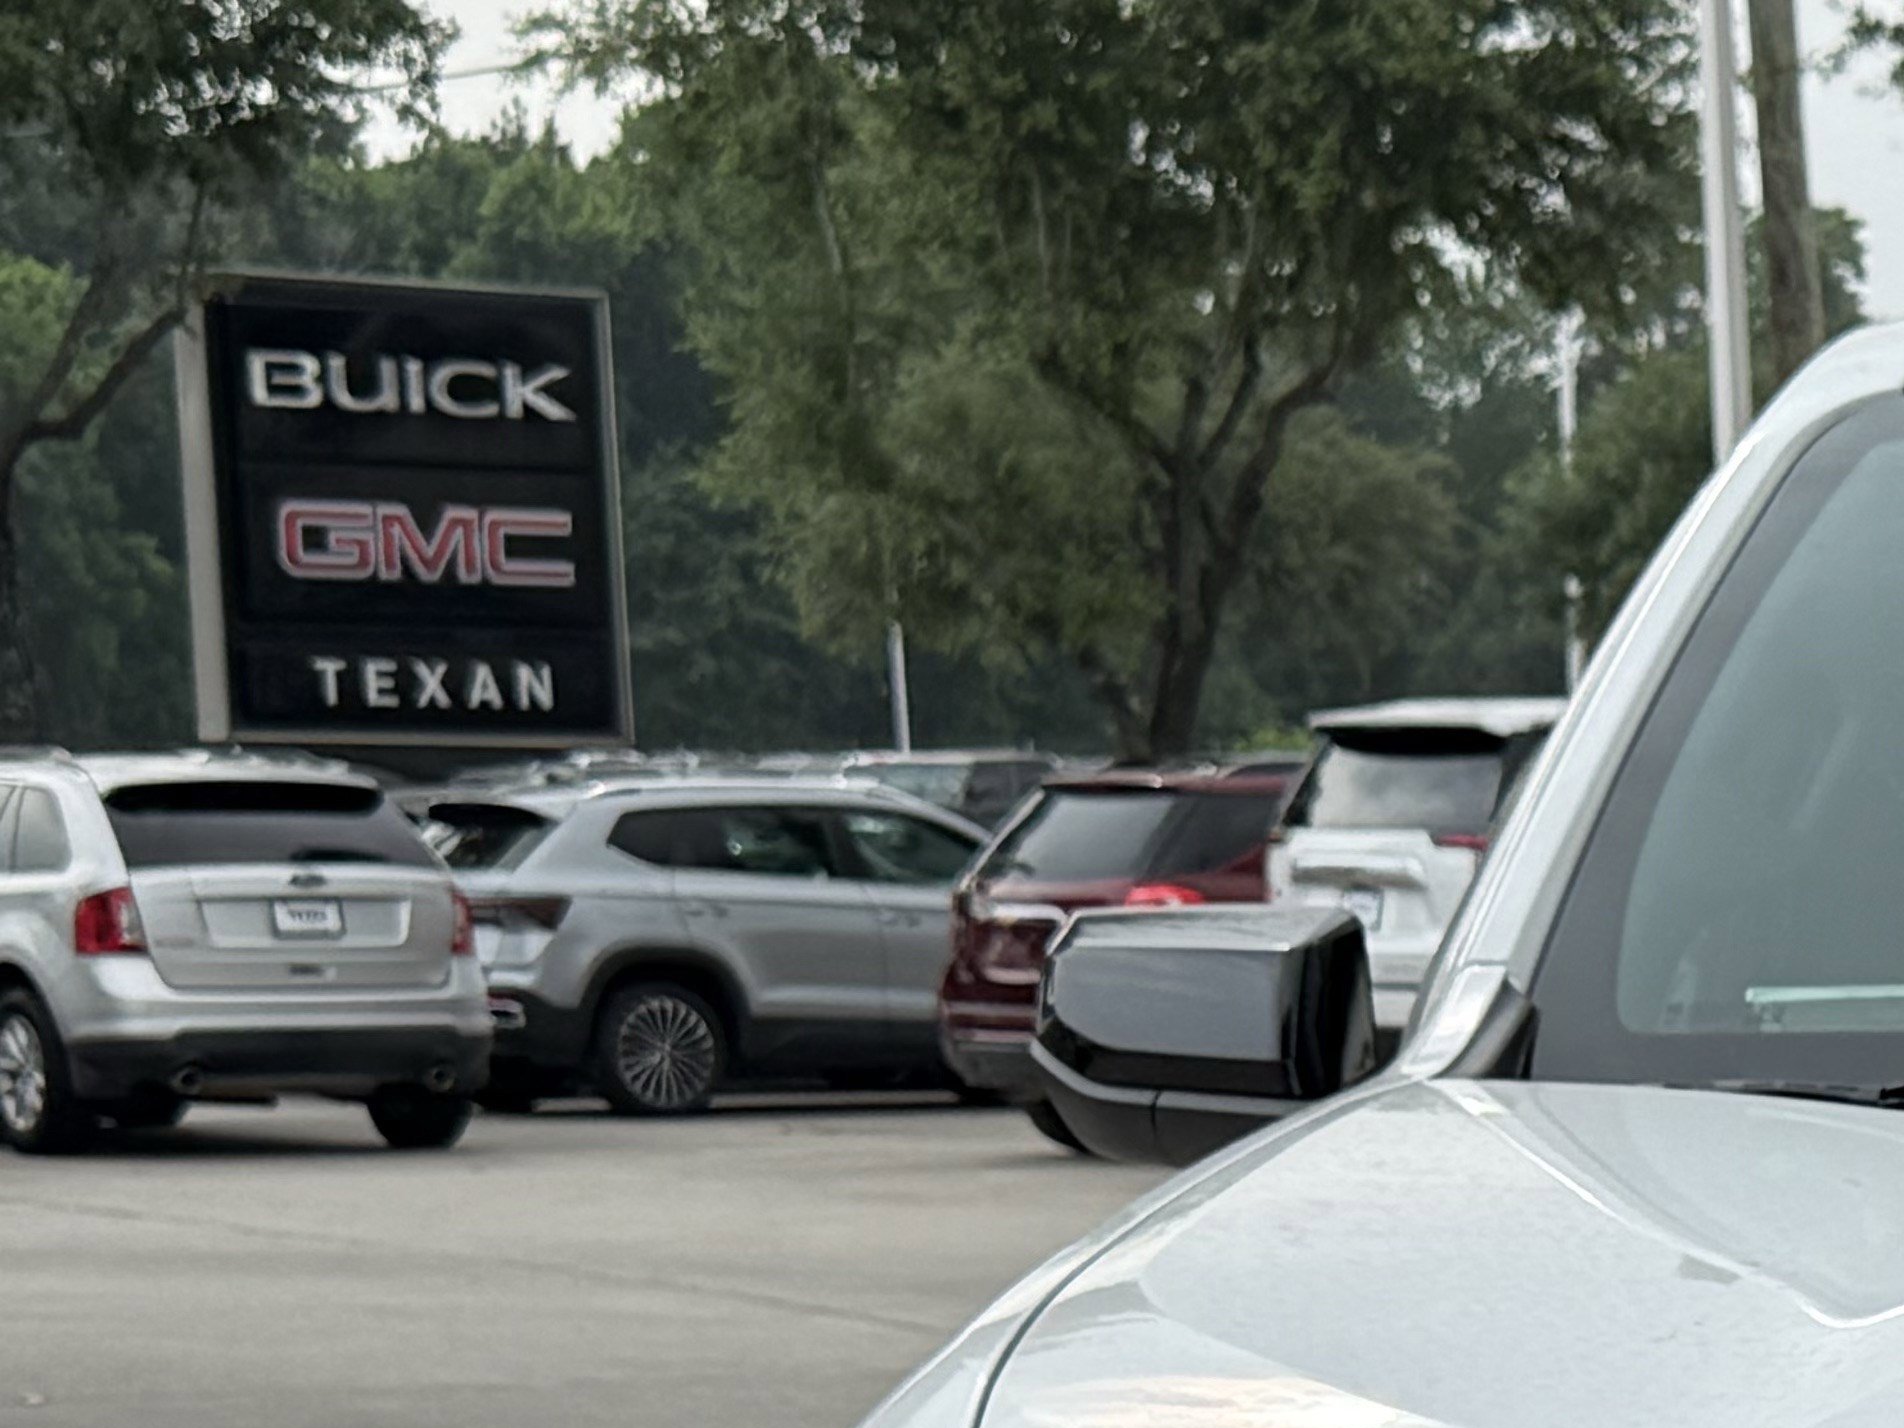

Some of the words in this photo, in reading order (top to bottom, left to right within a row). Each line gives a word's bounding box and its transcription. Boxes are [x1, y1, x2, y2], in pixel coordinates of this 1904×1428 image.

[246, 347, 576, 422] BUICK
[278, 501, 575, 587] GMC
[309, 654, 554, 712] TEXAN
